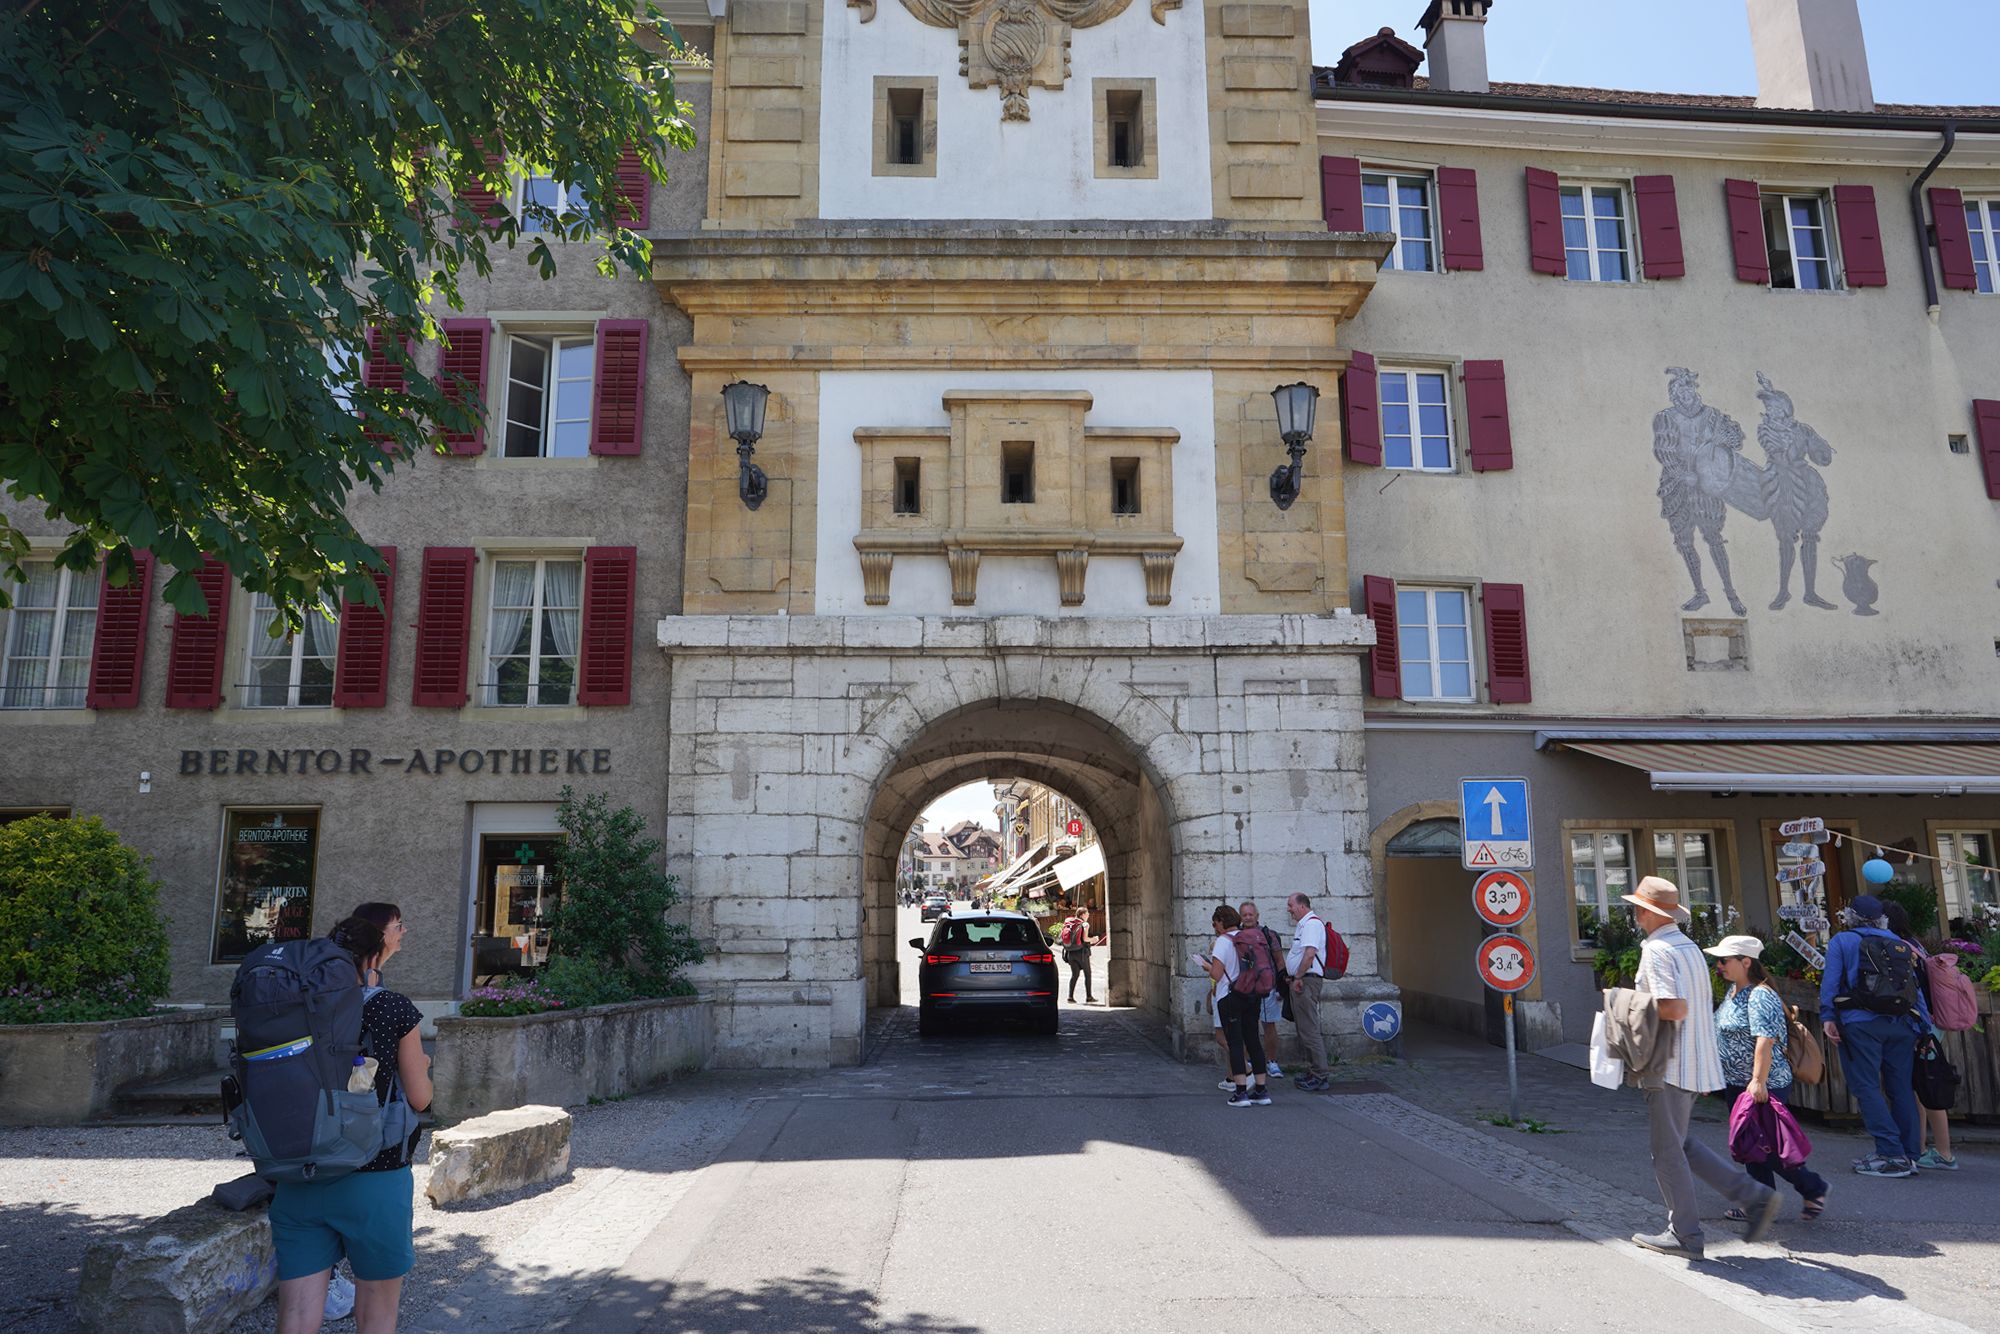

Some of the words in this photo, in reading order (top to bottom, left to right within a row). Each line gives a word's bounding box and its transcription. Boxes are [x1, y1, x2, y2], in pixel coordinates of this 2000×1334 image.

[179, 748, 612, 776] BERNTOR-APOTHEKE
[1071, 822, 1080, 833] B
[238, 829, 308, 842] BERNTOR-APOTHEKE
[271, 886, 308, 897] MURTEN
